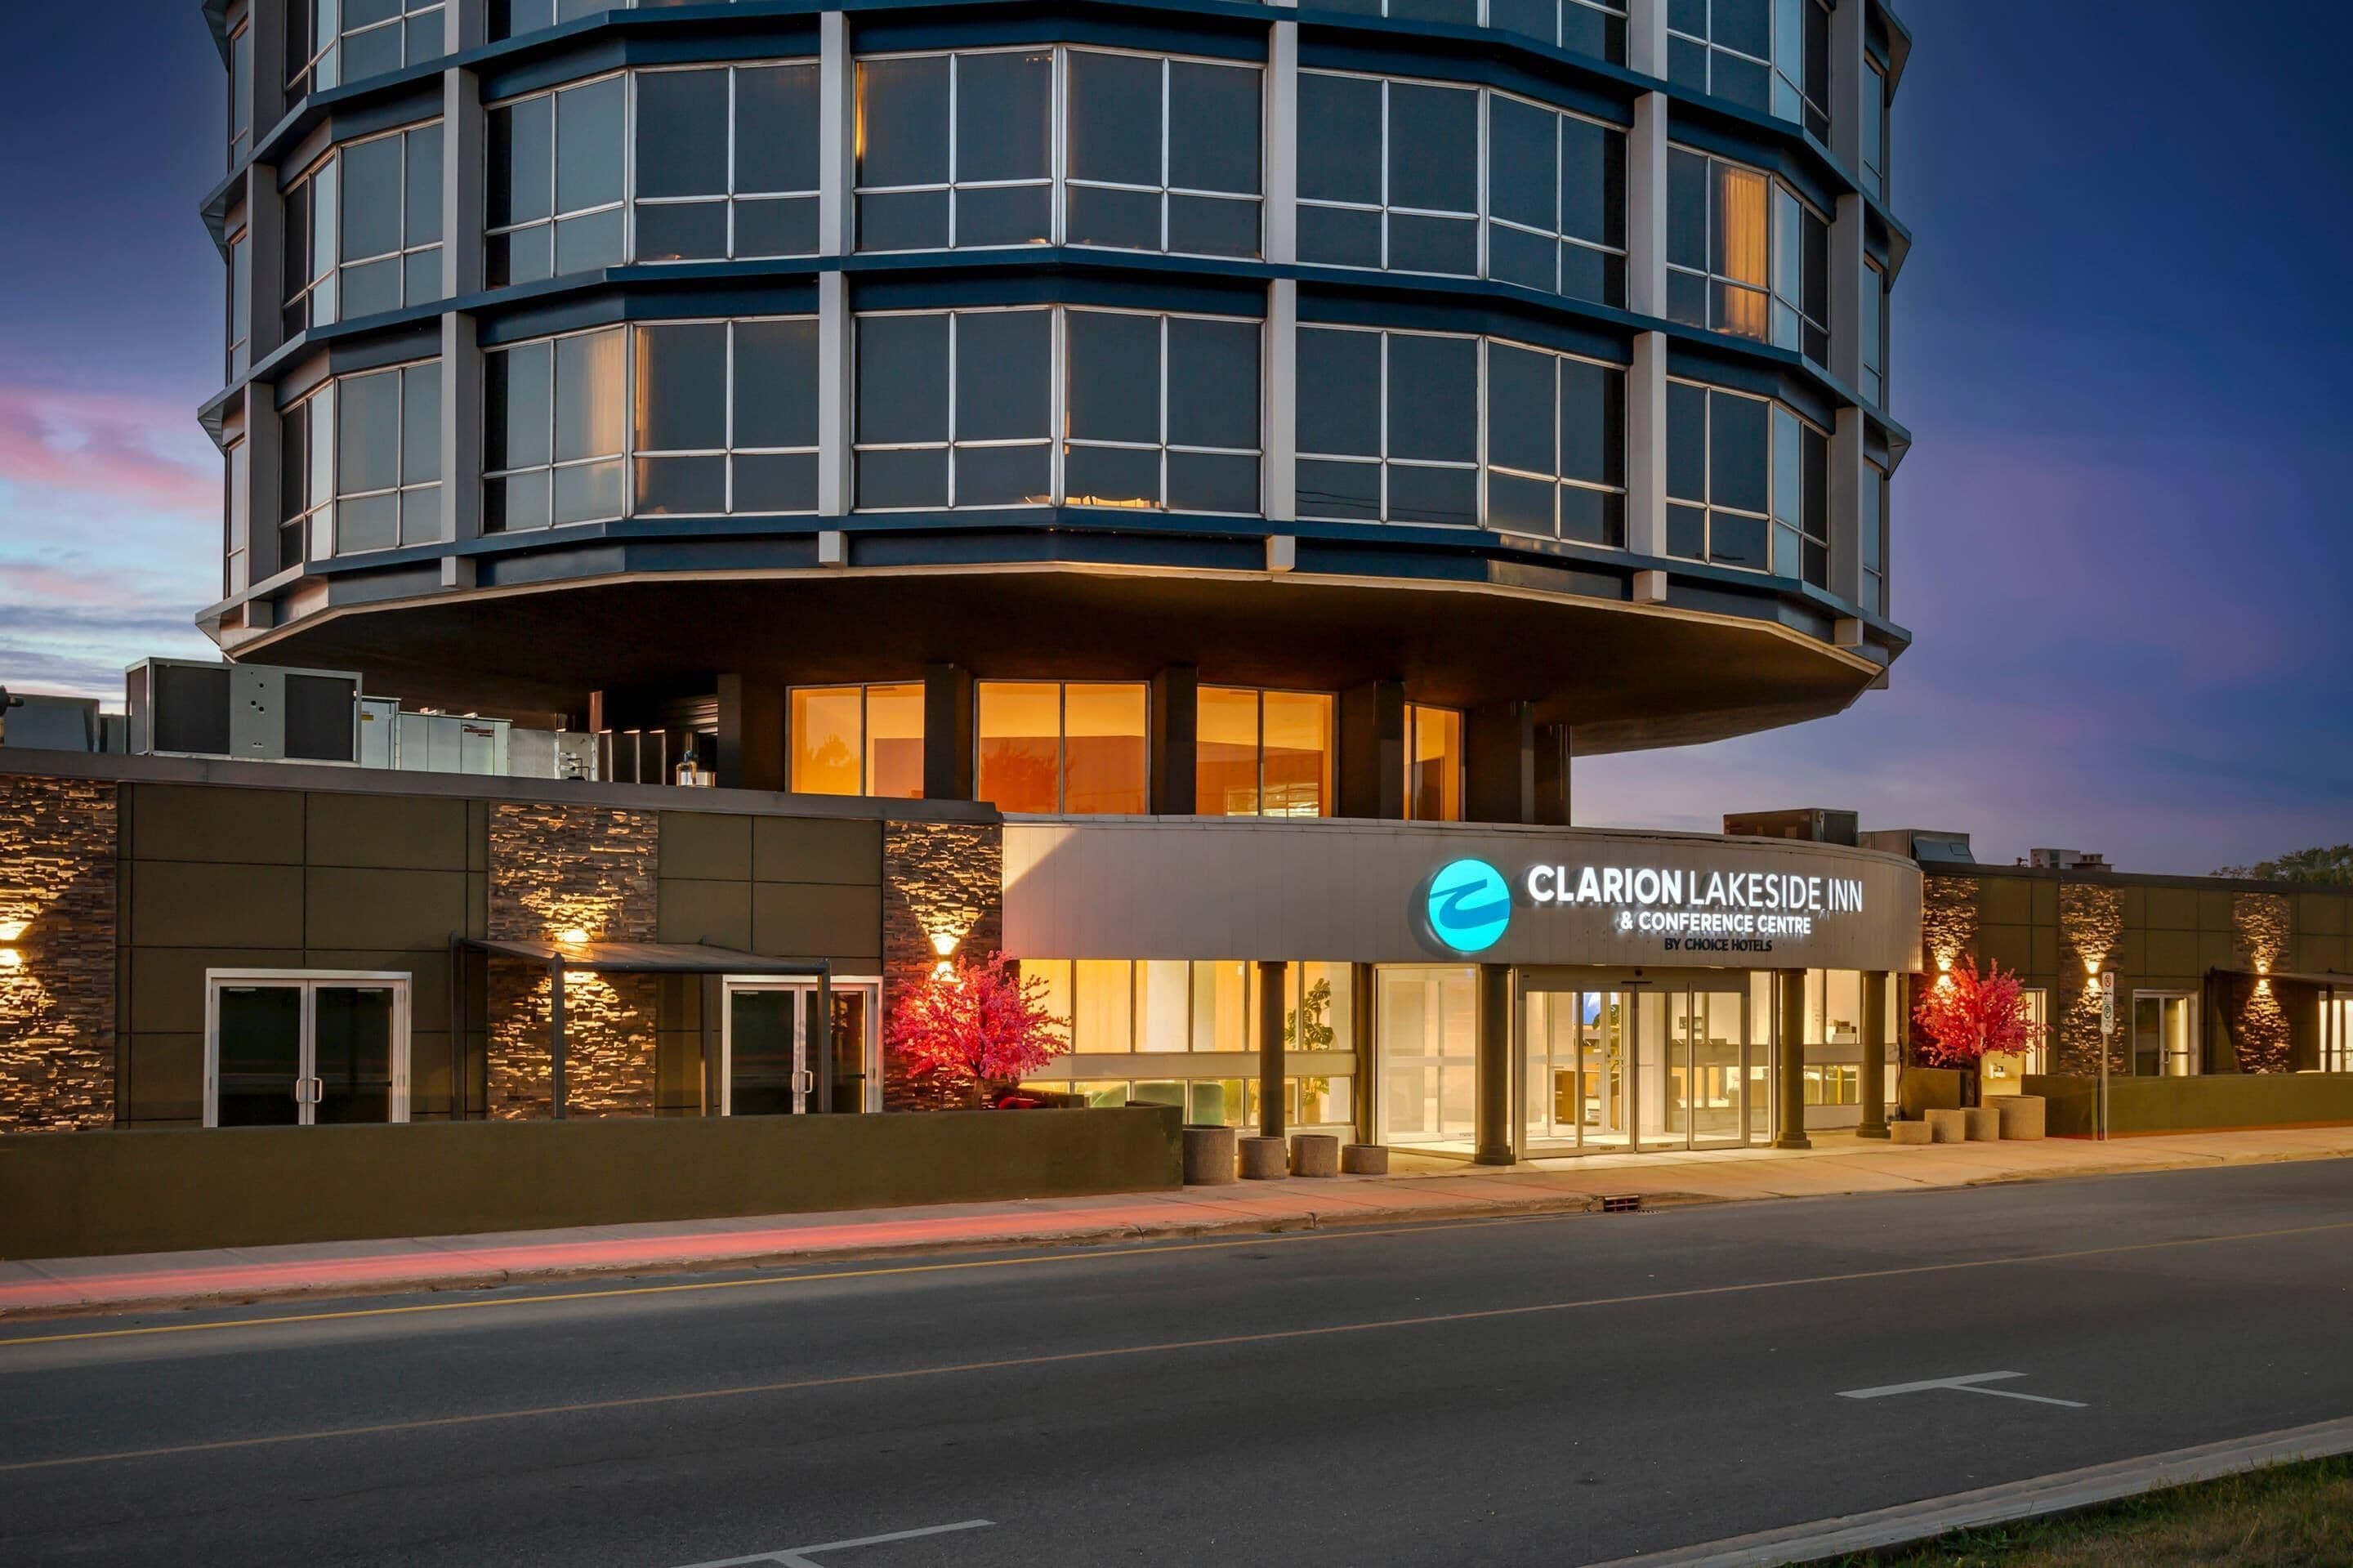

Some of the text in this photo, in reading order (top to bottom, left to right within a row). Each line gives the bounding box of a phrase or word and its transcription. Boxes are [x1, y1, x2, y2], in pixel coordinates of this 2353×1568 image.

[1528, 864, 1862, 913] CLARION LAKESIDE INN
[1620, 911, 1811, 934] & CONFERENCE CENTRE
[1664, 938, 1773, 952] BY CHOICE HOTELS
